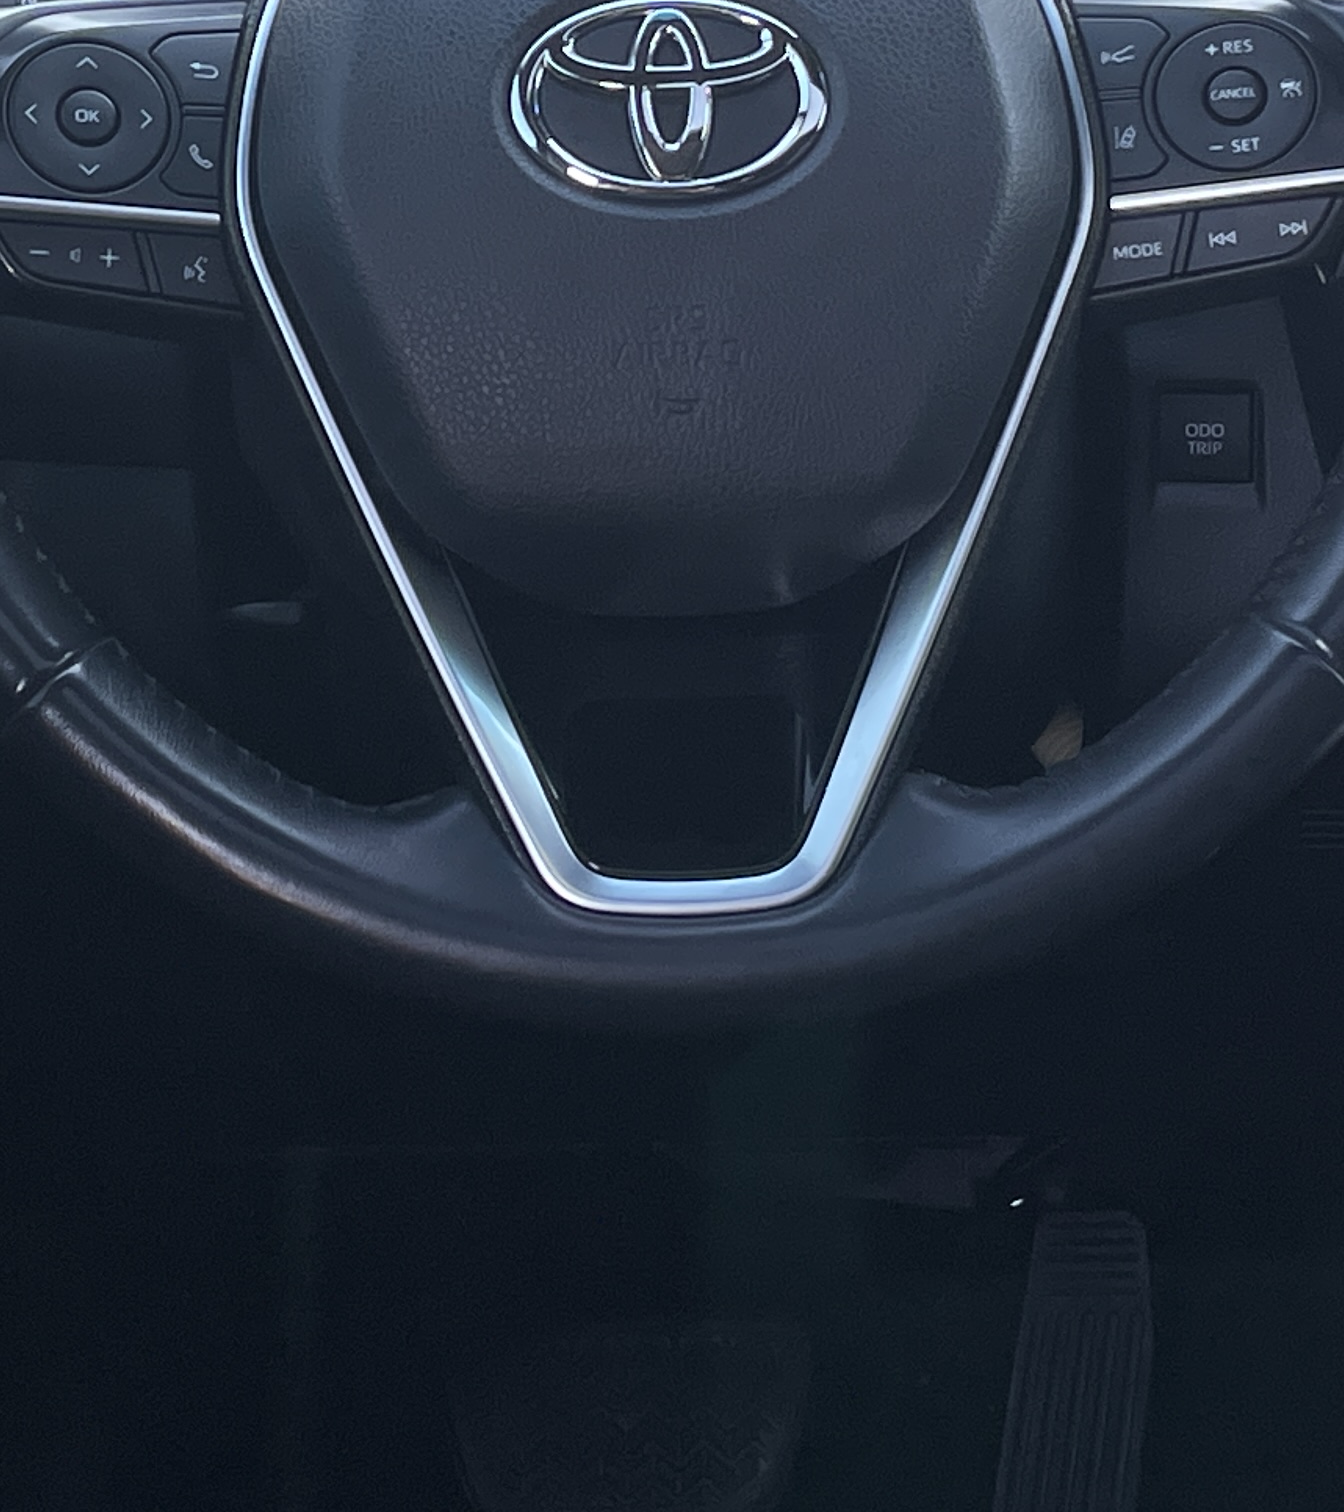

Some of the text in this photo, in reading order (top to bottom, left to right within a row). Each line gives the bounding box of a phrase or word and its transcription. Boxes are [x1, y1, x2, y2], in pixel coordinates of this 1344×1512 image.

[1209, 87, 1256, 102] CANCEL
[74, 108, 100, 124] OK
[1112, 241, 1163, 261] MODE
[1185, 422, 1225, 439] ODO
[1187, 440, 1223, 456] TRIP
